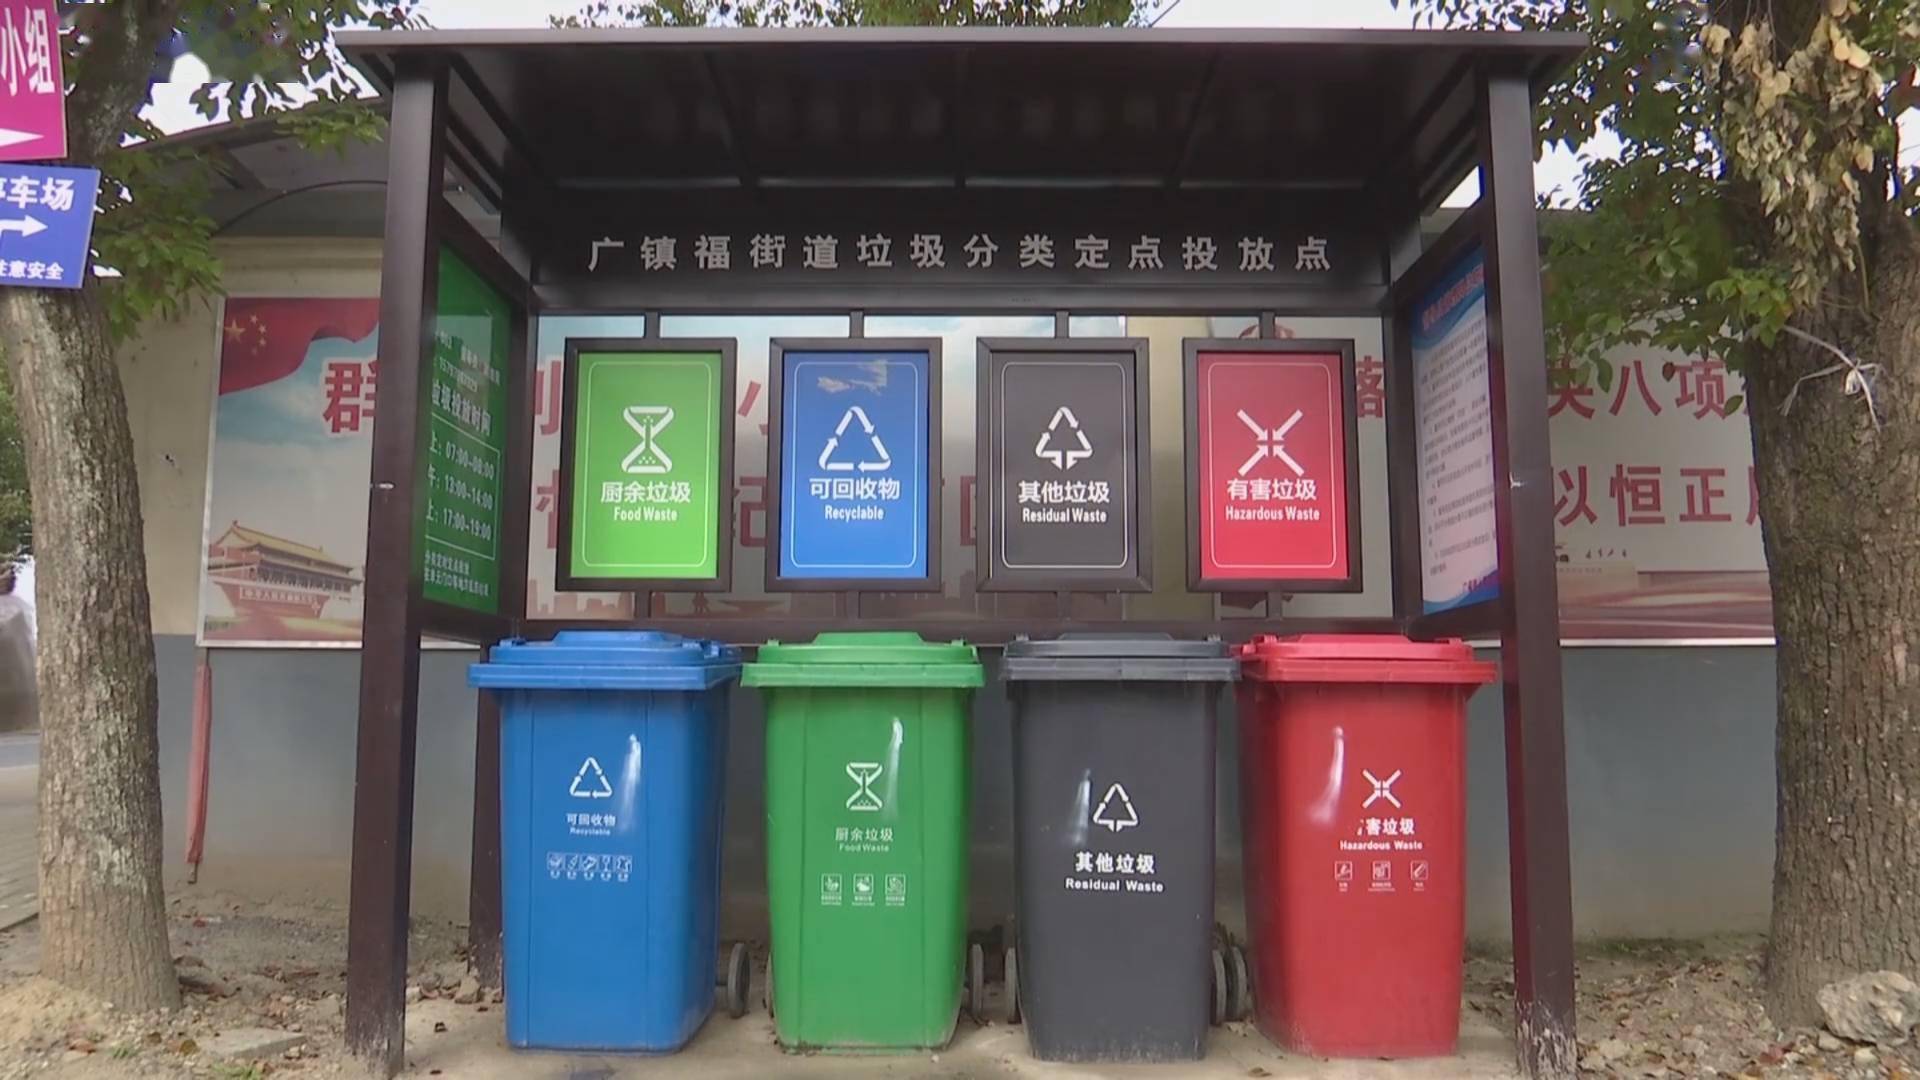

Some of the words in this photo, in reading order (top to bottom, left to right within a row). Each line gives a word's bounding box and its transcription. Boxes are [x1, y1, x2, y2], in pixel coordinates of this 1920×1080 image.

[0, 8, 55, 96] 小组
[588, 233, 1331, 271] 广镇福街道垃圾分类定点投放点
[600, 481, 692, 504] 厨余垃圾
[809, 477, 901, 501] 可回收物
[1018, 480, 1111, 505] 其他垃圾
[1226, 478, 1317, 502] 有害垃圾
[1553, 464, 1758, 527] 以恒正
[613, 505, 643, 522] Food
[644, 506, 678, 522] Waste
[824, 504, 885, 522] Recyclable
[1022, 507, 1070, 523] Residual
[1072, 508, 1107, 523] Waste
[1225, 505, 1284, 521] Hazardous
[1285, 506, 1320, 521] Waste
[566, 813, 616, 827] 可回收物
[1357, 817, 1415, 836] 害垃圾
[835, 827, 894, 842] 厨余垃圾
[839, 843, 862, 852] Food
[863, 844, 890, 853] Waste
[1340, 840, 1391, 851] Hazardous
[1394, 840, 1423, 851] Waste
[1075, 851, 1155, 875] 其他垃圾
[1065, 878, 1121, 892] Residual
[1125, 880, 1164, 892] Waste
